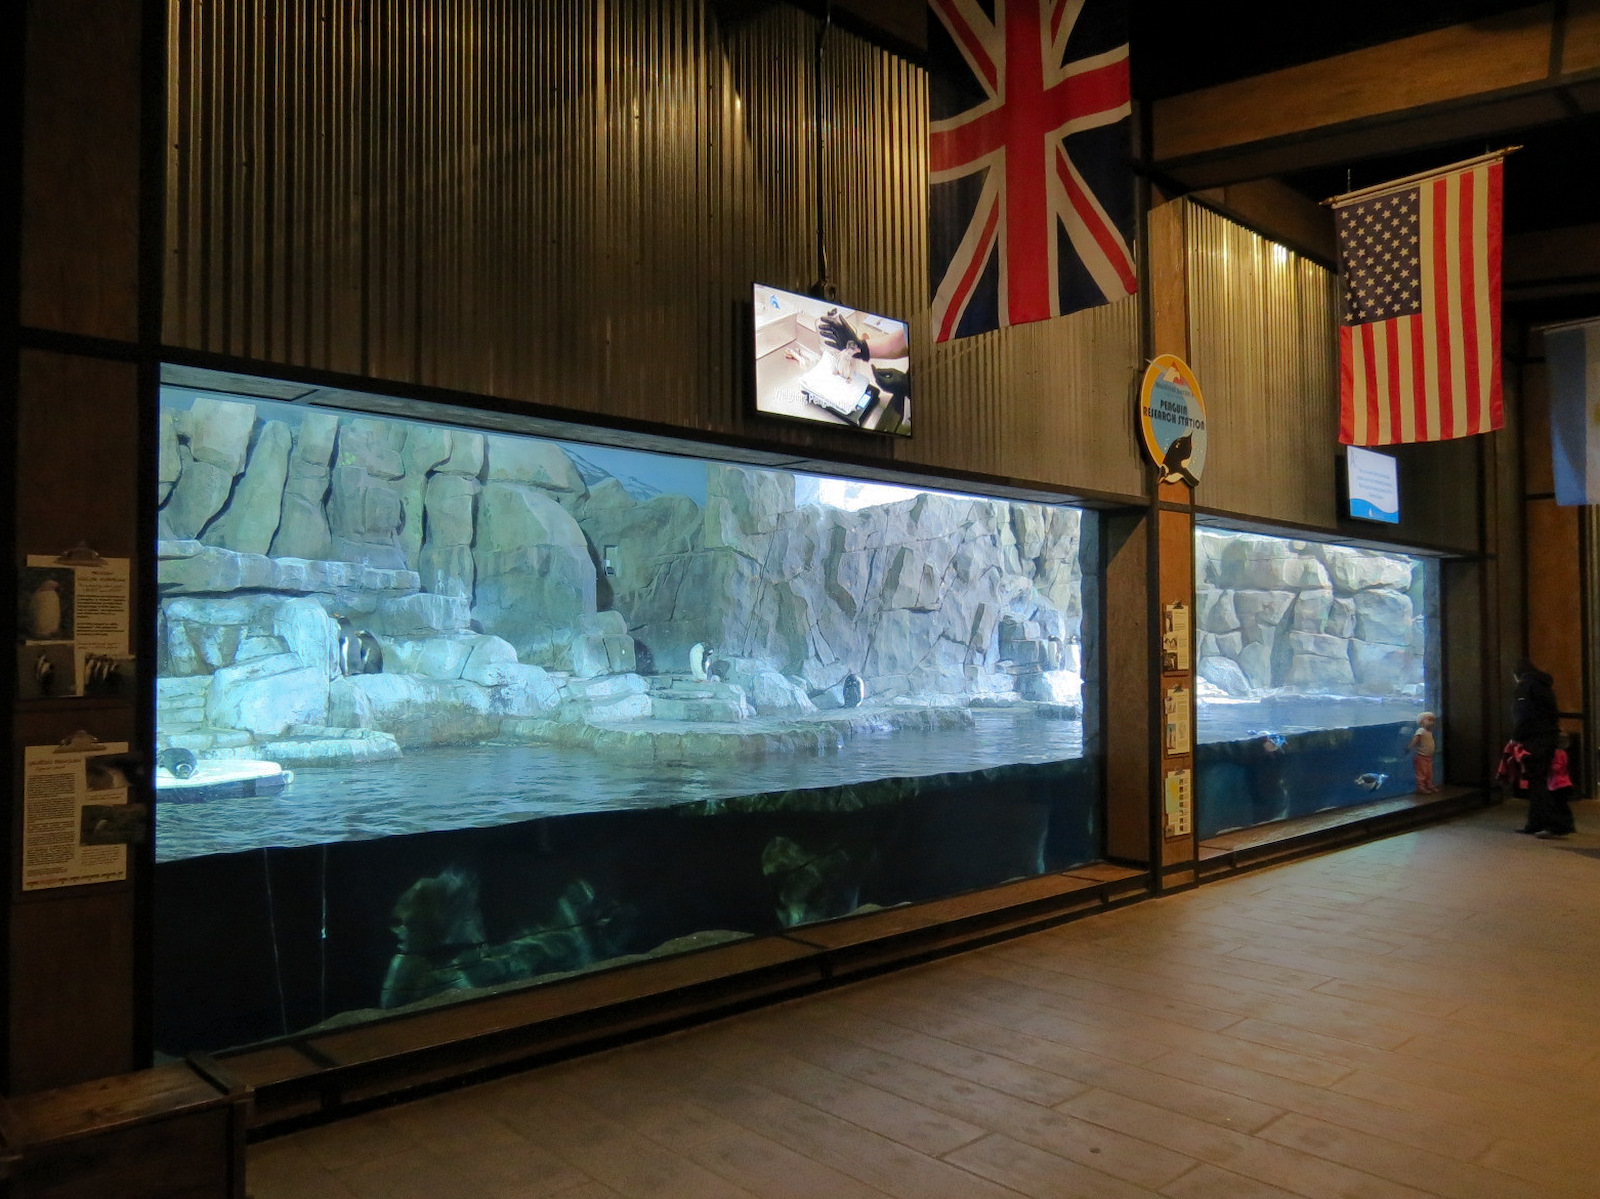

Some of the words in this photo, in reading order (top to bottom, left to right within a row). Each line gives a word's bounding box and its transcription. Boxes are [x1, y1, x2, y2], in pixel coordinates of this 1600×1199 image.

[1160, 399, 1188, 416] PENGUIN
[1143, 406, 1176, 424] RESEARCH
[1178, 415, 1205, 431] STATION
